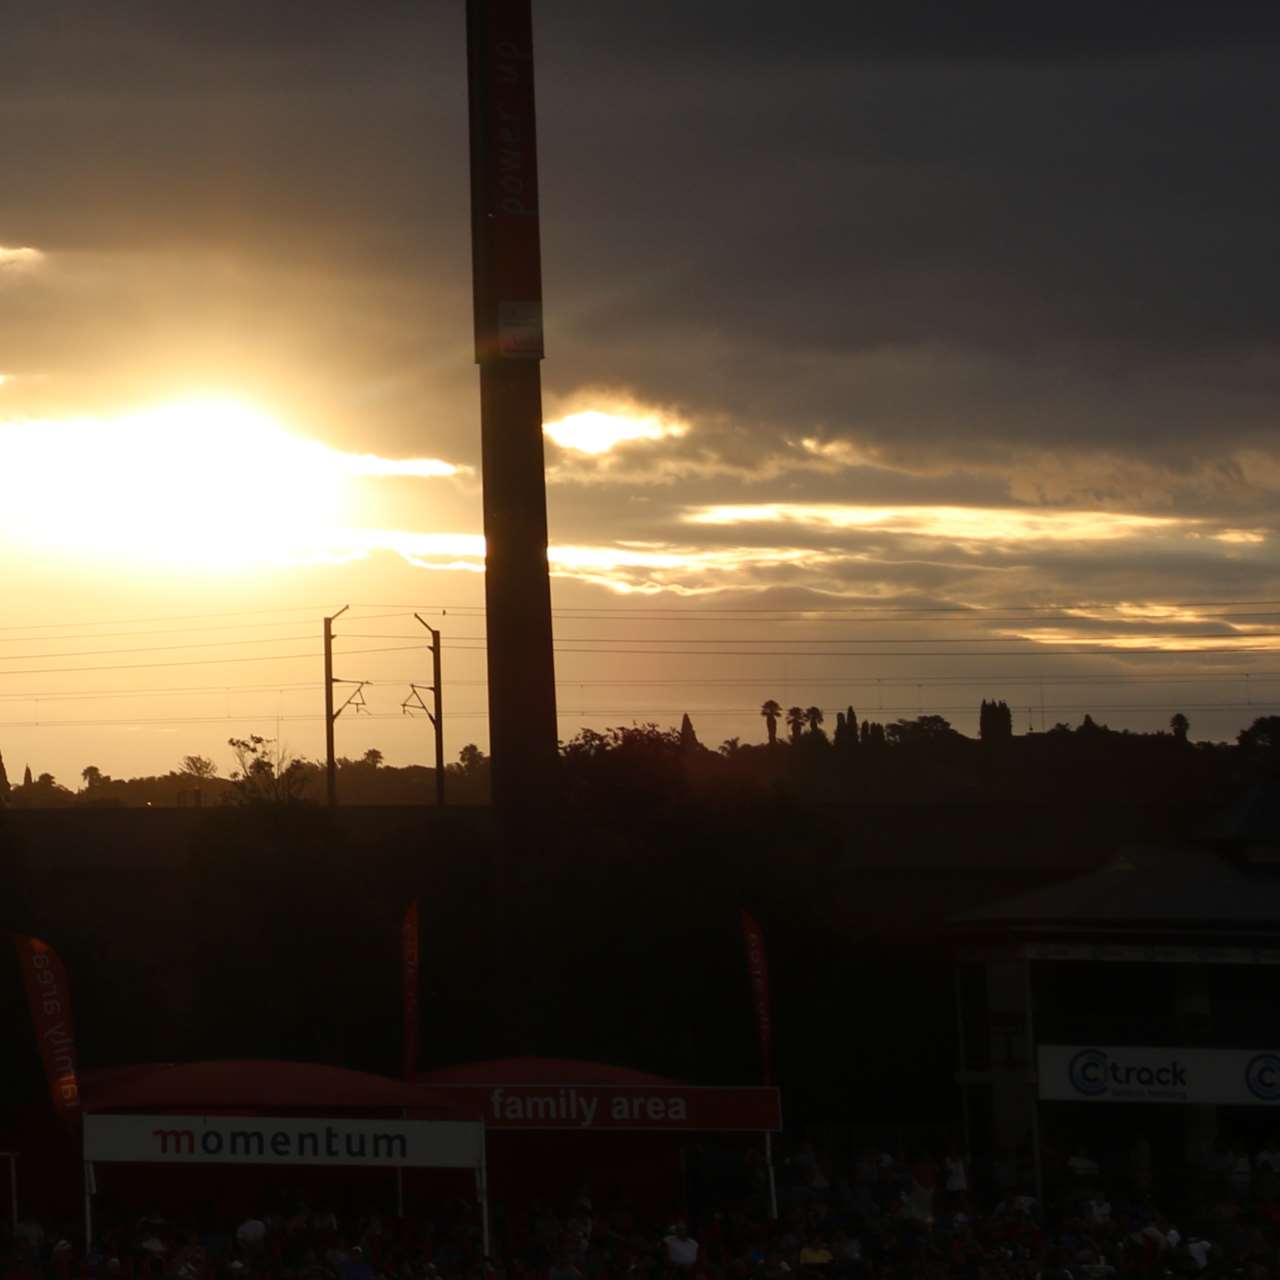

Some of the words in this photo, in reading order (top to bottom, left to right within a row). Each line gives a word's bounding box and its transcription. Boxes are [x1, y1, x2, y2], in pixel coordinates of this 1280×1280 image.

[489, 1088, 598, 1128] family
[610, 1094, 688, 1121] area
[152, 1126, 407, 1158] momentum
